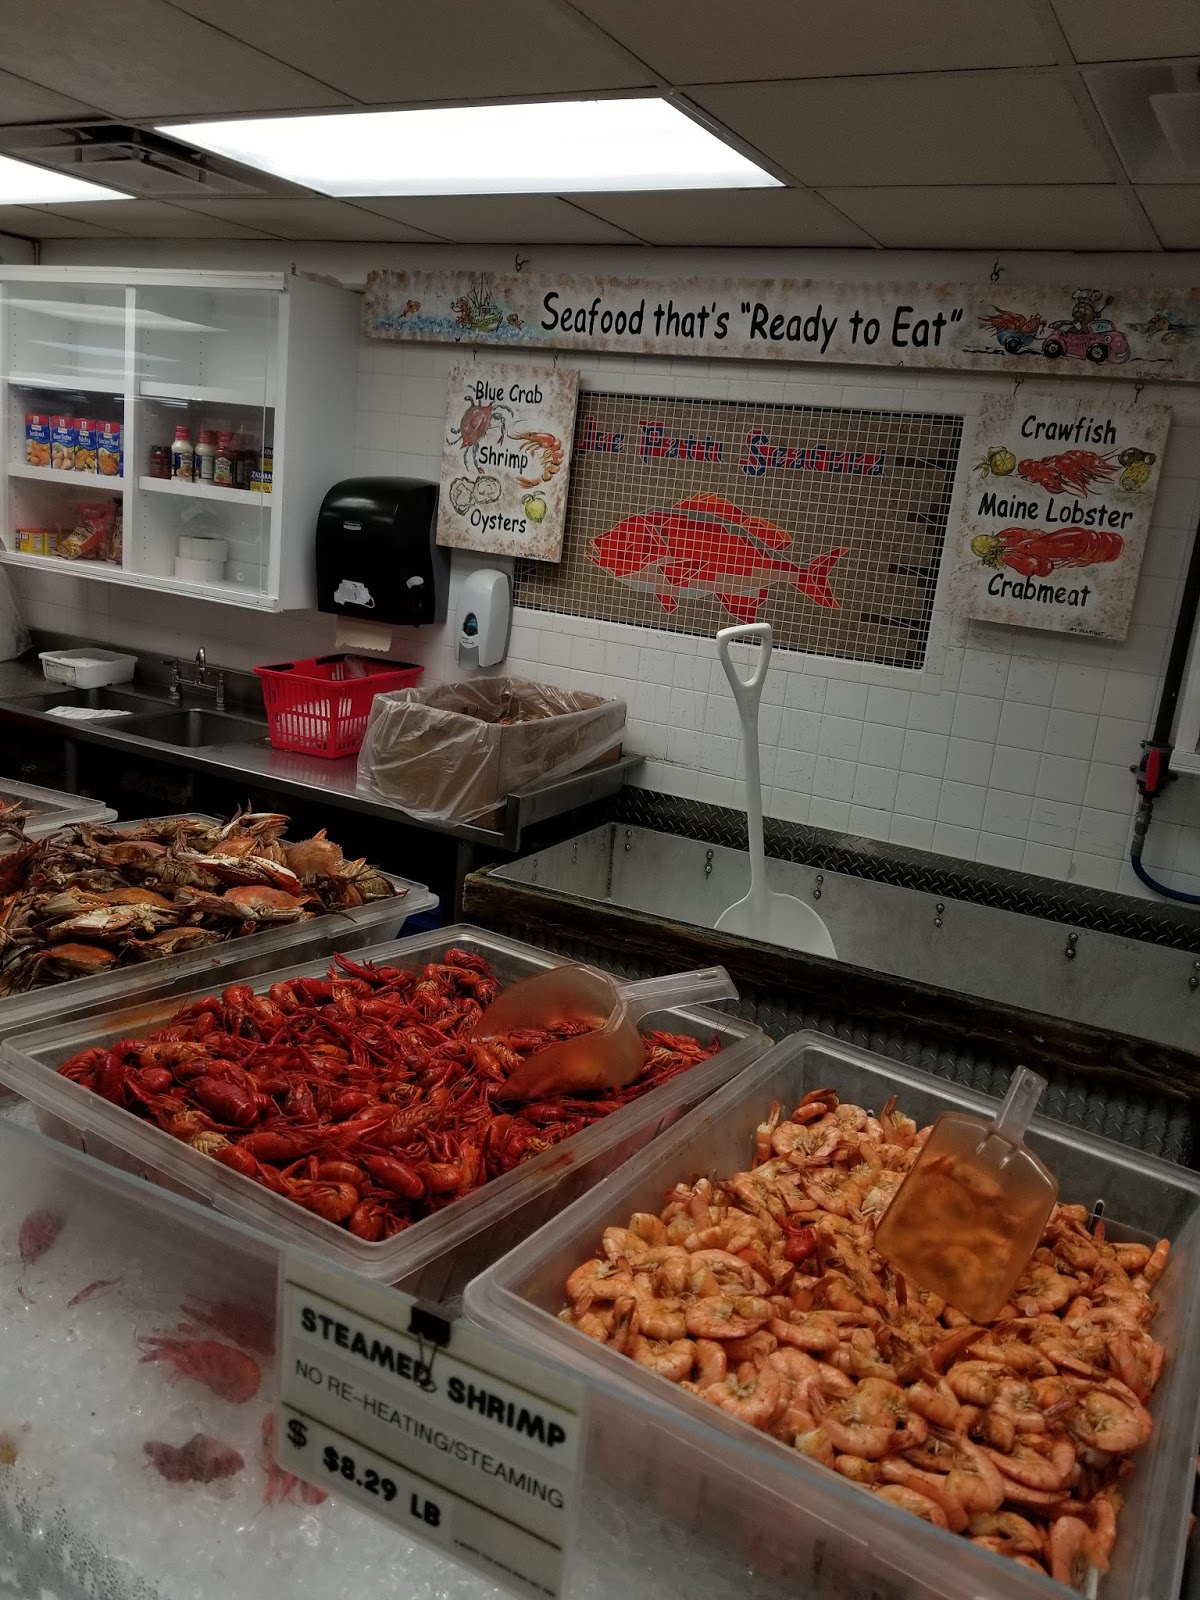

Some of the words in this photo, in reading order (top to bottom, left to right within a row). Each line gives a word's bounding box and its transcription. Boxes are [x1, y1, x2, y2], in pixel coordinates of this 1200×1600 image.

[541, 291, 643, 337] Seafood
[653, 300, 729, 340] that's
[741, 303, 835, 354] "Ready
[849, 310, 880, 346] to
[892, 306, 963, 348] Eat"
[475, 380, 504, 401] Blue
[509, 384, 543, 404] Crab
[1021, 415, 1117, 444] Crawfish
[478, 446, 528, 474] Shrimp
[470, 508, 527, 534] Oysters
[978, 492, 1039, 520] Maine
[1046, 498, 1134, 529] Lobster
[987, 573, 1091, 607] Crabmeat
[301, 1307, 432, 1386] STEAMED
[446, 1376, 566, 1448] SHRIMP
[295, 1359, 322, 1385] NO
[327, 1376, 564, 1509] RE-HEATING/STEAMING
[287, 1418, 308, 1449] $
[322, 1446, 397, 1501] $8.29
[410, 1494, 440, 1527] LB
